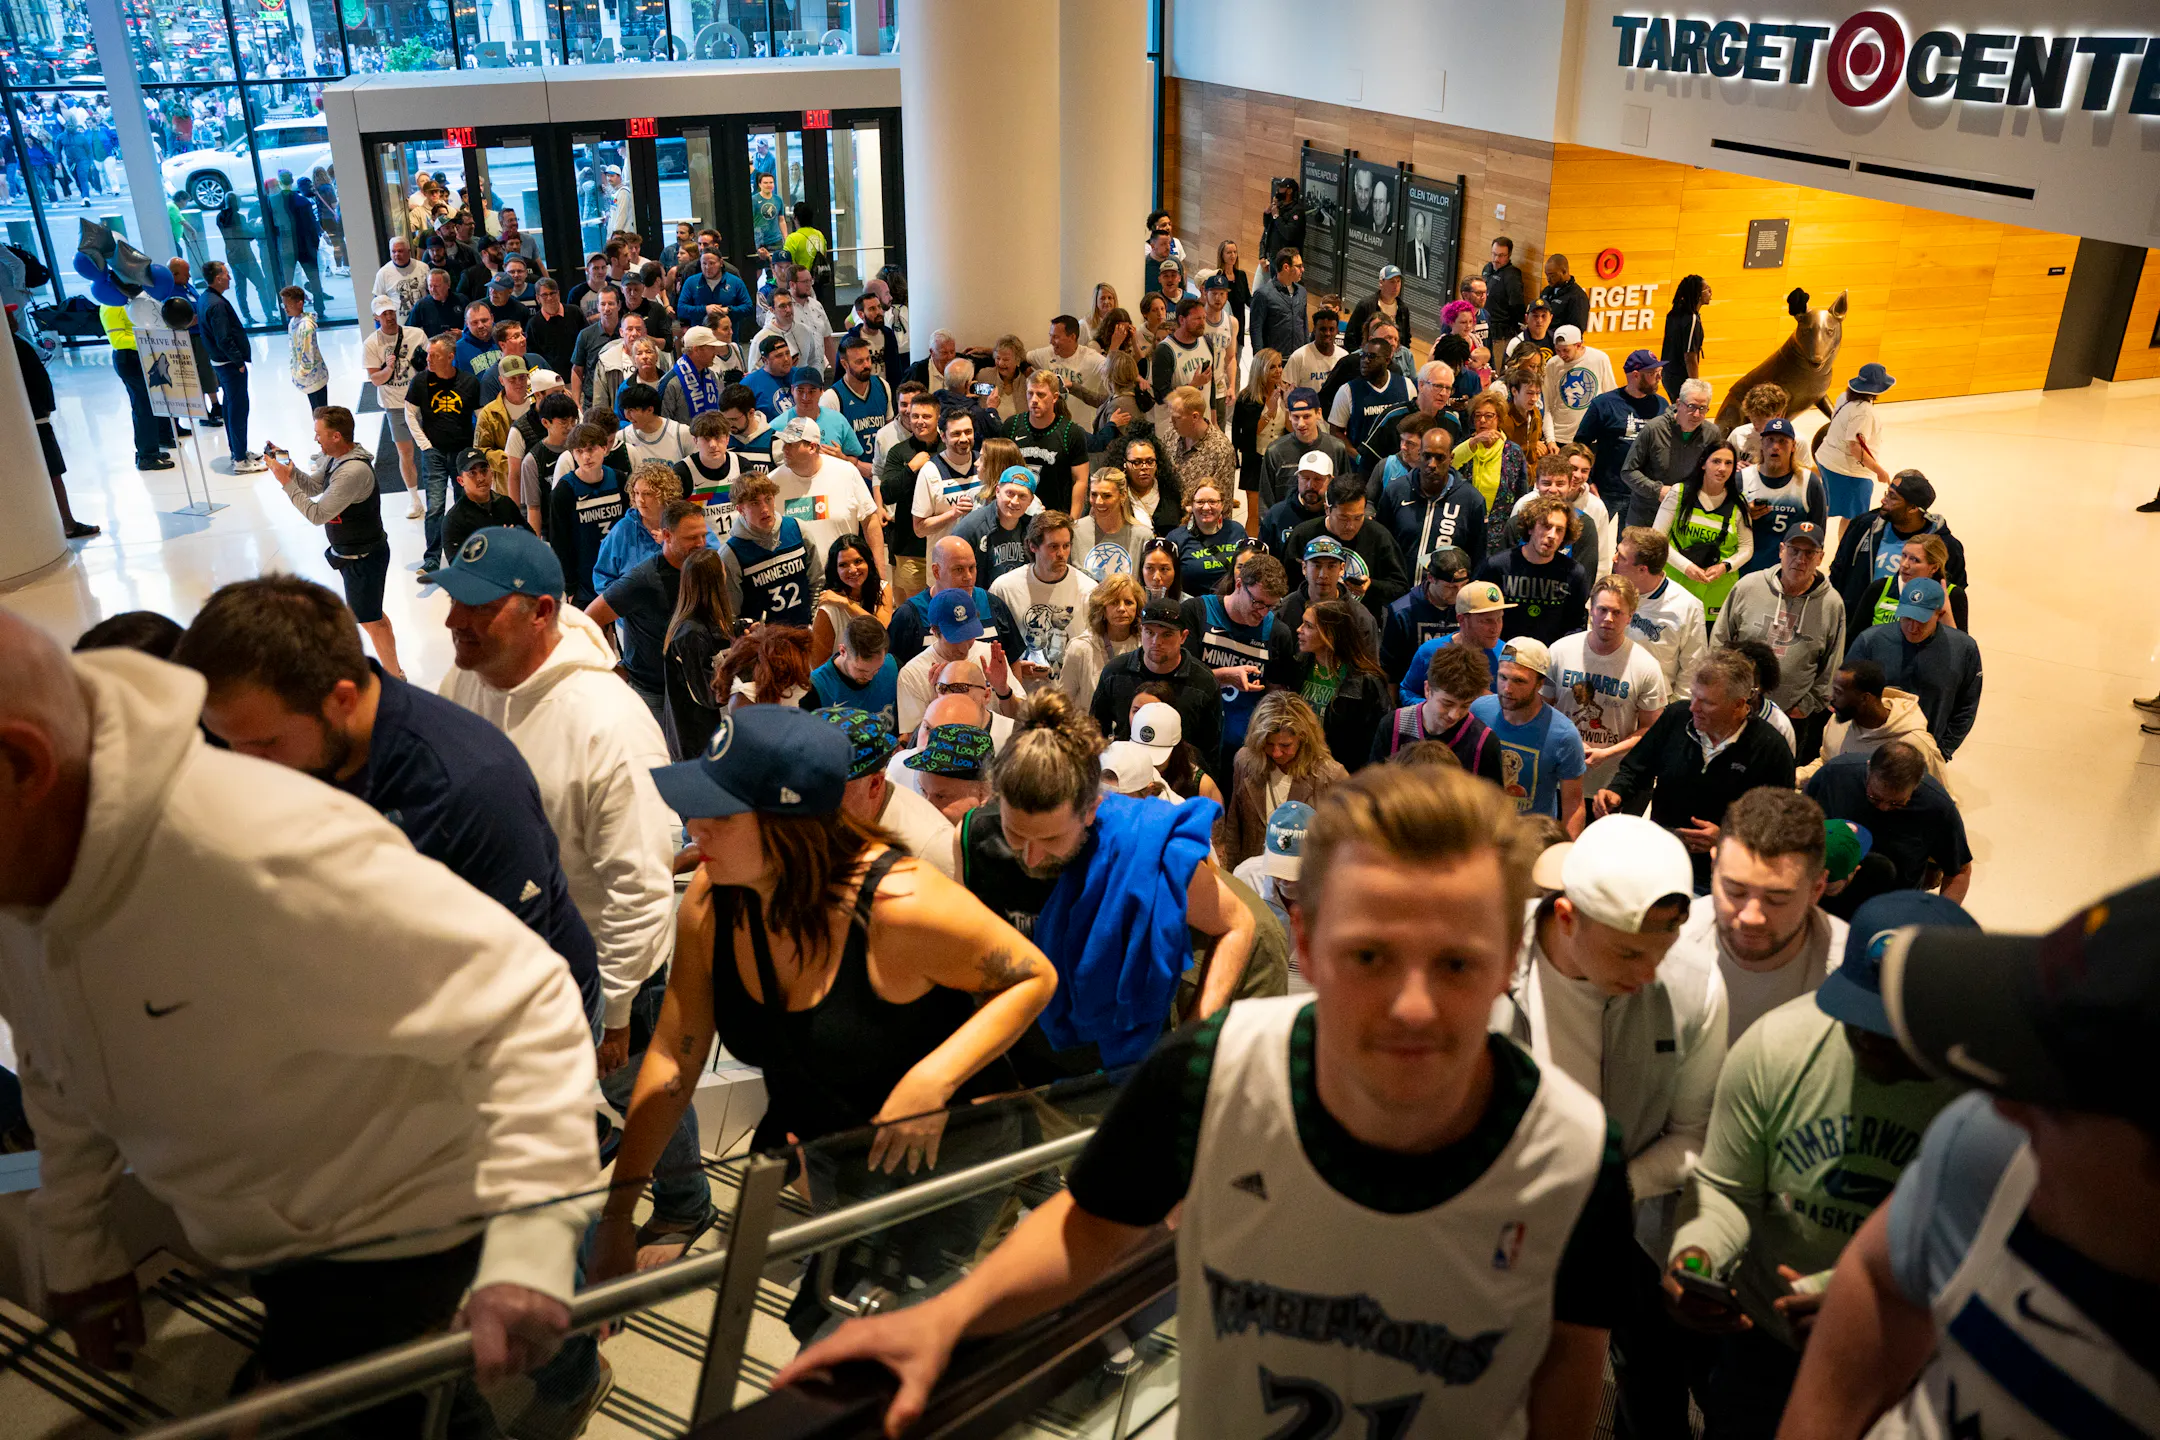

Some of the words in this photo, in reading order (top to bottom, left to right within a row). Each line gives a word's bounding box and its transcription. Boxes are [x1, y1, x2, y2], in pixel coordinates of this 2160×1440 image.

[1612, 15, 1830, 85] TARGET
[630, 118, 655, 136] EXIT
[806, 110, 830, 128] EXIT
[447, 128, 474, 147] EXIT
[1306, 167, 1338, 182] MINNEAPOLIS
[1410, 188, 1426, 201] GLEN
[1427, 192, 1449, 207] TAYLOR
[1349, 228, 1364, 241] MARV
[1368, 235, 1383, 247] HARV
[1590, 284, 1658, 308] RGET
[1587, 309, 1655, 333] NTER
[138, 337, 169, 346] THRIVE
[171, 338, 188, 347] BAR
[786, 505, 810, 515] HURLEY
[1772, 514, 1788, 533] 5
[752, 558, 805, 587] MINNESOTA
[767, 581, 802, 612] 32
[1502, 574, 1571, 601] WOLVES
[1561, 669, 1630, 700] EDWARDS
